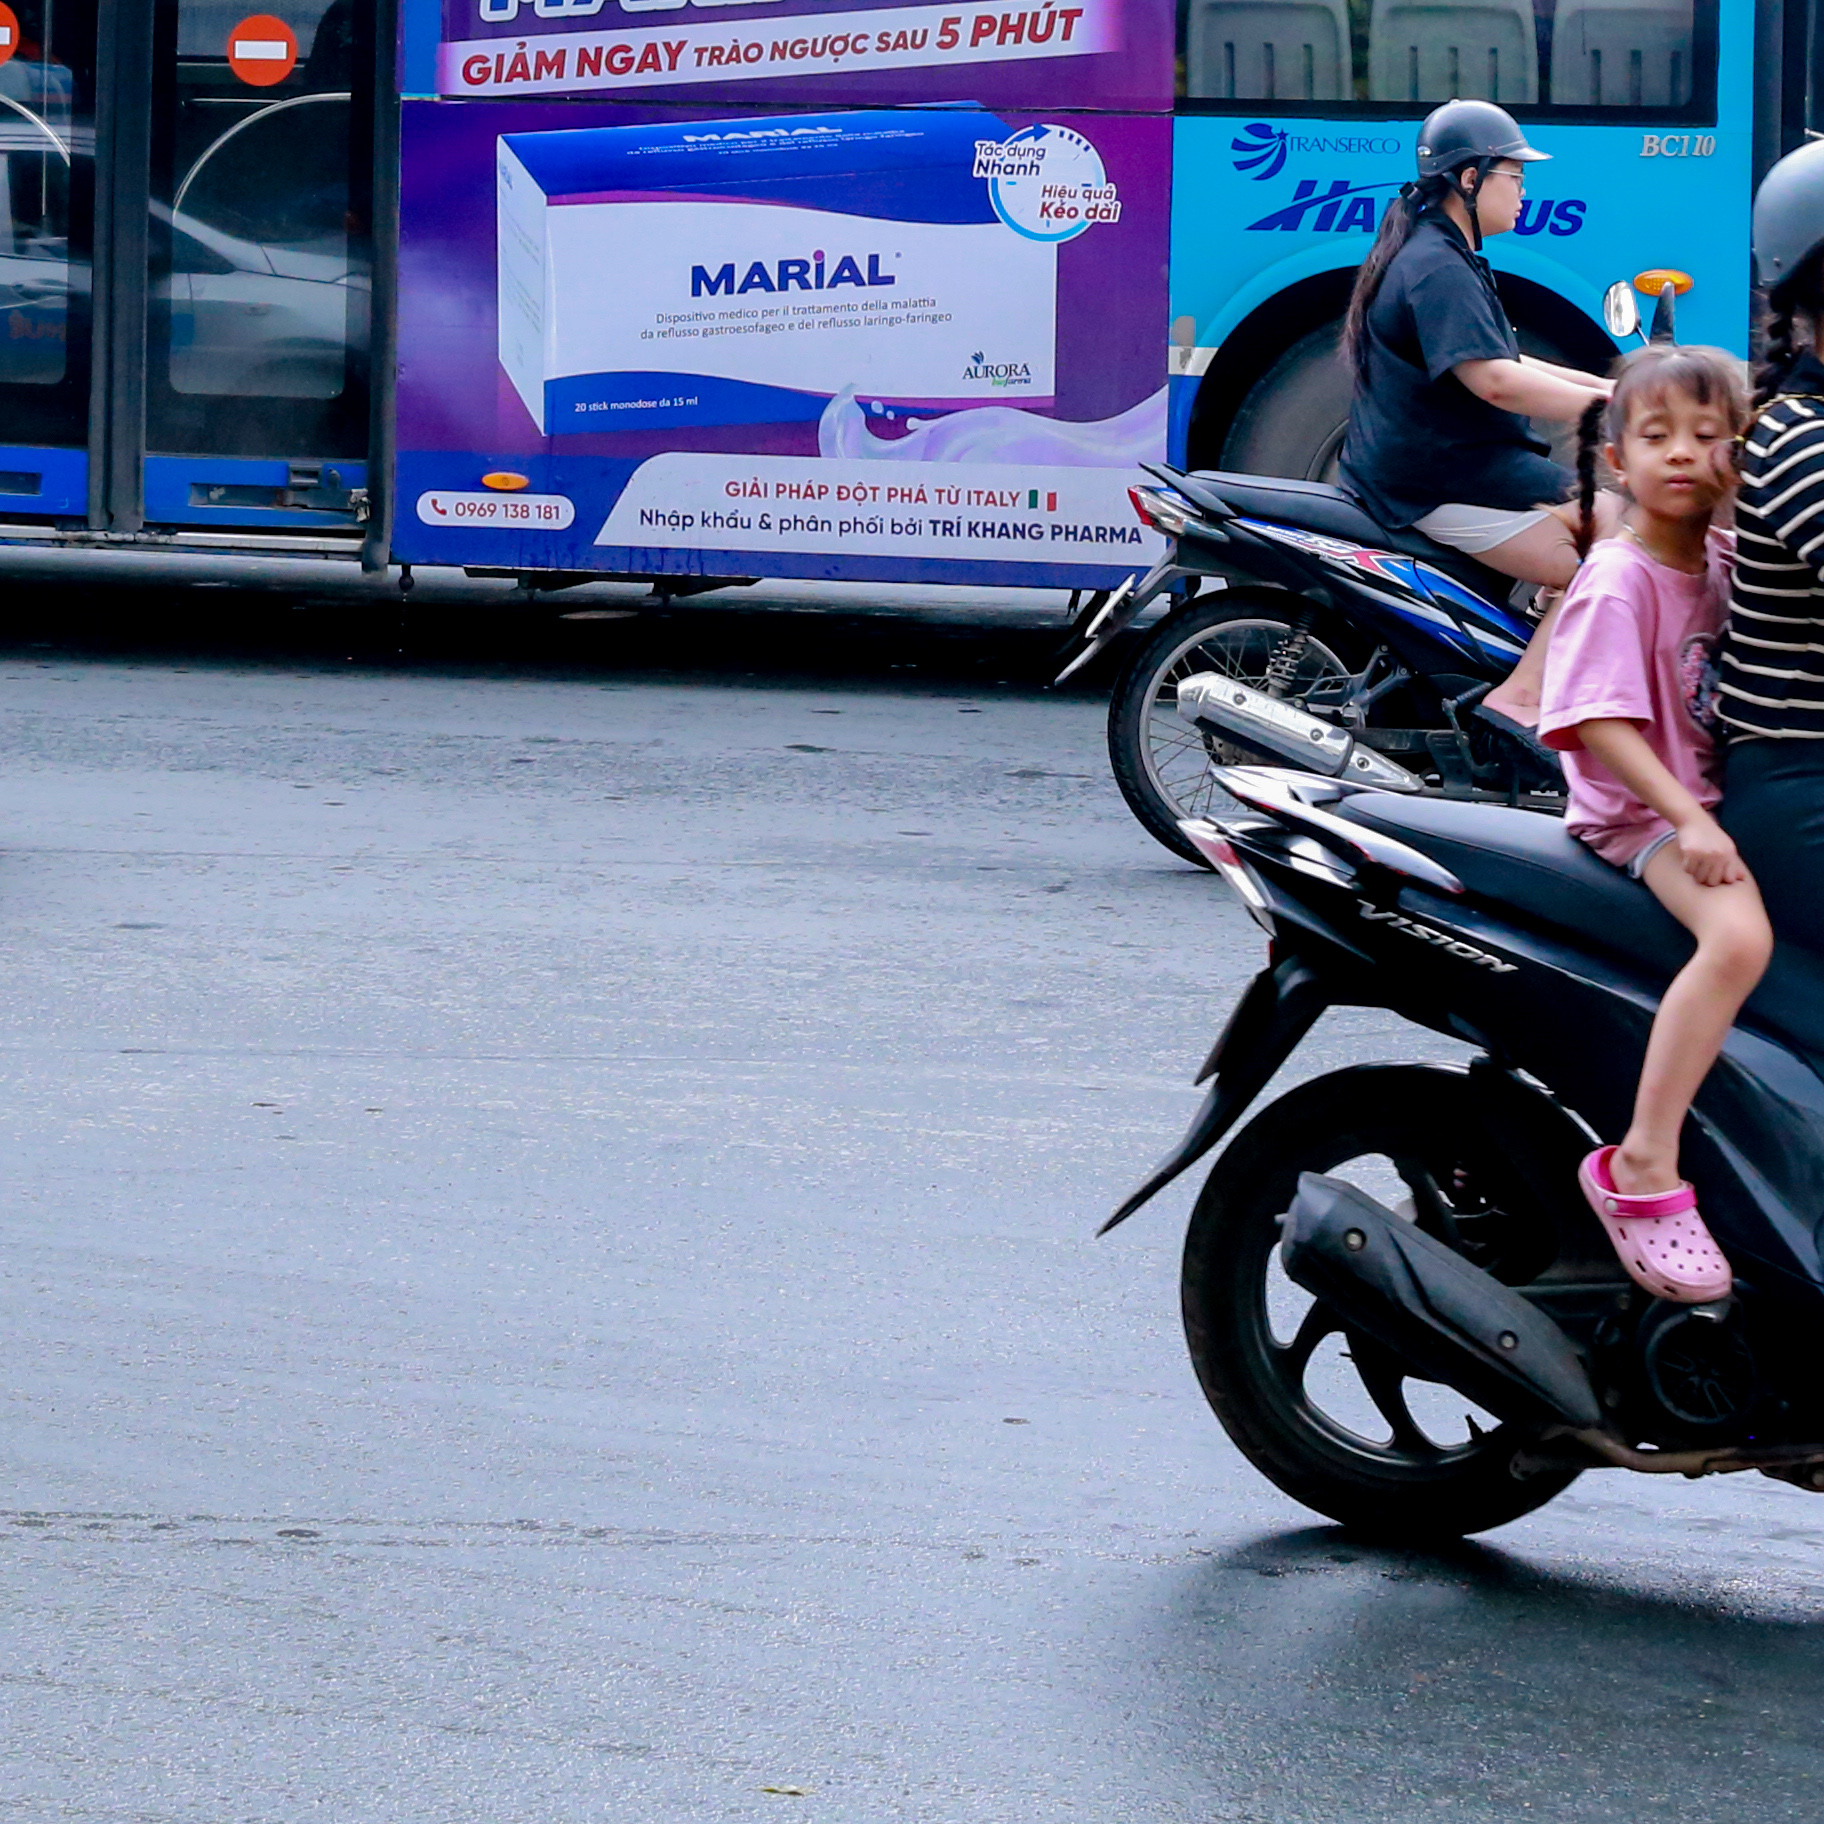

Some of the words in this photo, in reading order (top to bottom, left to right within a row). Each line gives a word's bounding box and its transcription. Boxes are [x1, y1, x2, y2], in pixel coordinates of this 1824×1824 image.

[462, 43, 567, 87] GIẢM
[575, 39, 688, 78] NGAY
[692, 40, 763, 67] TRÀO
[769, 33, 869, 65] NGƯỢC
[875, 25, 928, 52] SAU
[935, 18, 962, 49] 5
[969, 1, 1084, 48] PHÚT
[977, 142, 1004, 157] Tác
[1007, 144, 1046, 160] dụng
[1289, 137, 1401, 155] TRANSERCO
[976, 159, 1041, 176] Nhanh
[1041, 185, 1078, 202] Hiệu
[1082, 186, 1115, 202] quả
[1085, 203, 1120, 220] dài
[656, 309, 716, 325] Dispositivo
[718, 308, 759, 322] medico
[761, 308, 780, 319] per
[783, 305, 789, 316] il
[792, 302, 859, 317] trattamento
[862, 299, 889, 311] della
[891, 297, 936, 309] malattia
[640, 328, 654, 340] da
[657, 325, 700, 339] reflusso
[702, 322, 786, 338] gastroesofageo
[788, 322, 795, 331] e
[797, 318, 815, 331] del
[817, 315, 862, 330] reflusso
[863, 311, 953, 327] laringo-faringeo
[962, 363, 1032, 380] AURORA
[575, 402, 587, 413] 20
[588, 400, 609, 412] stick
[611, 399, 658, 411] monodose
[659, 398, 671, 409] da
[673, 397, 684, 408] 15
[686, 396, 699, 407] ml
[725, 477, 770, 501] GIẢI
[776, 478, 831, 502] PHÁP
[836, 479, 882, 507] ĐỘT
[888, 481, 928, 505] PHÁ
[934, 482, 963, 507] TỪ
[967, 488, 1022, 508] ITALY
[455, 503, 497, 518] 0969
[502, 504, 531, 519] 138
[535, 504, 560, 520] 181
[639, 509, 695, 534] Nhập
[701, 506, 753, 530] khẩu
[757, 516, 773, 532] &
[778, 512, 832, 537] phân
[838, 511, 886, 538] phối
[891, 518, 924, 537] bởi
[929, 516, 962, 538] TRÍ
[967, 521, 1045, 541] KHANG
[1050, 524, 1143, 546] PHARMA
[1356, 898, 1519, 973] VISION
